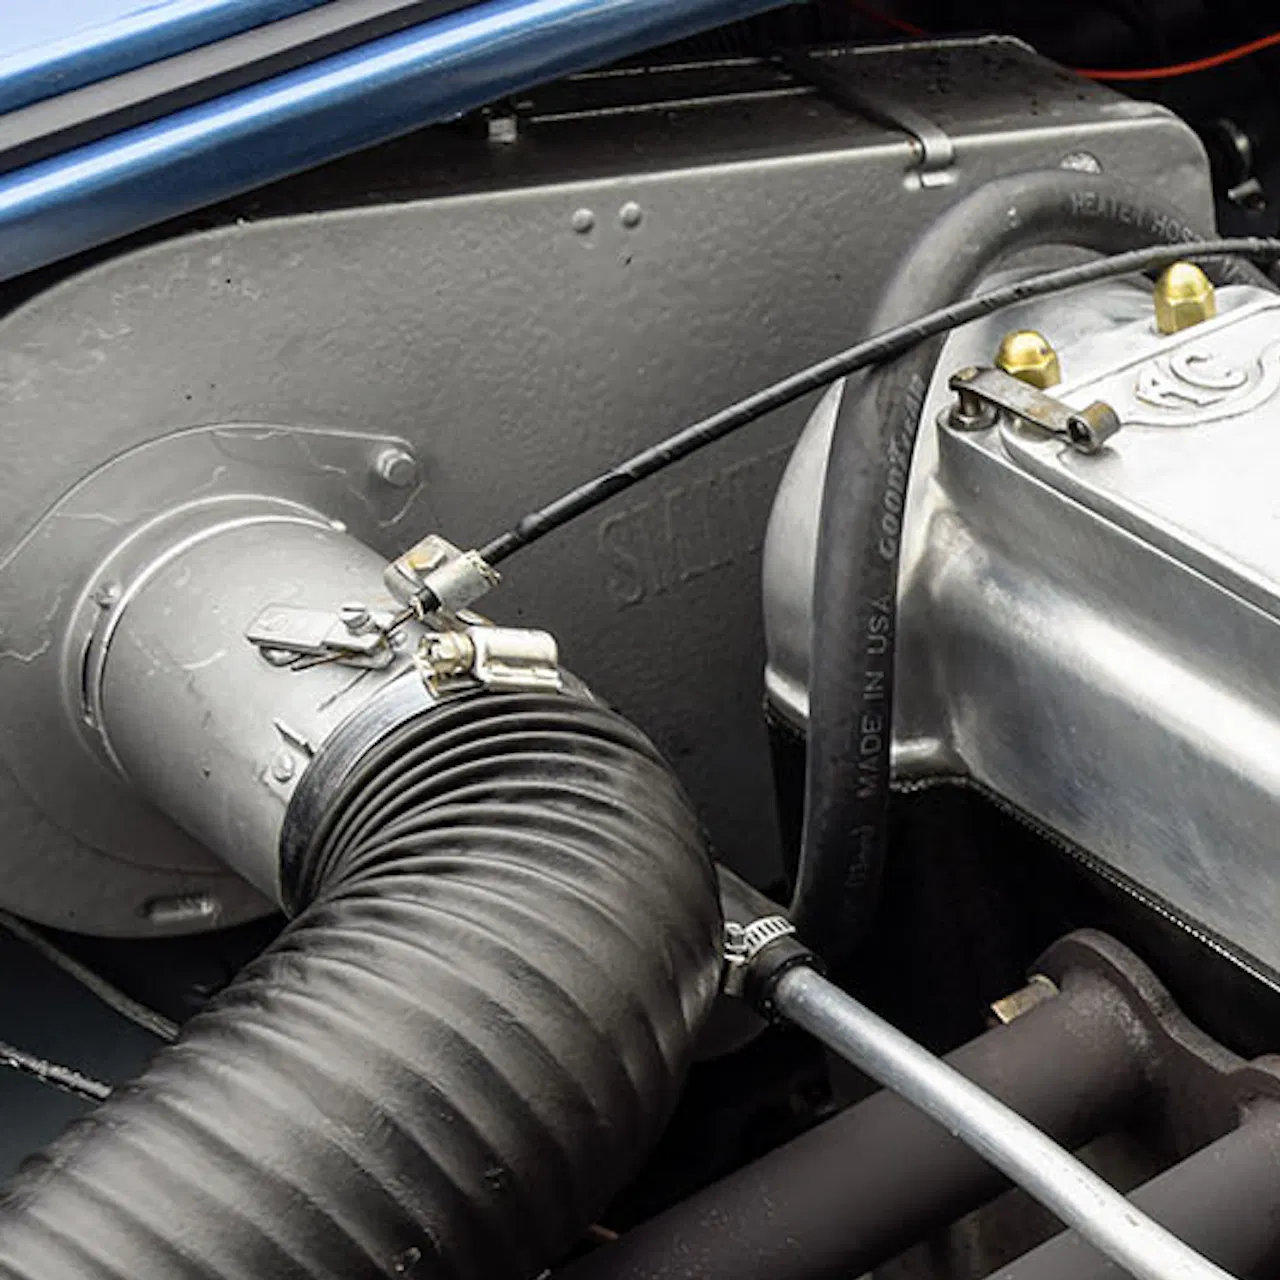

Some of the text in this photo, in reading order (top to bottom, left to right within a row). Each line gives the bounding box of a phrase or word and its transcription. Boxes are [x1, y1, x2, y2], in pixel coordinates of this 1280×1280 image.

[866, 593, 893, 655] USA
[863, 670, 885, 701] IN
[856, 714, 883, 799] MADE
